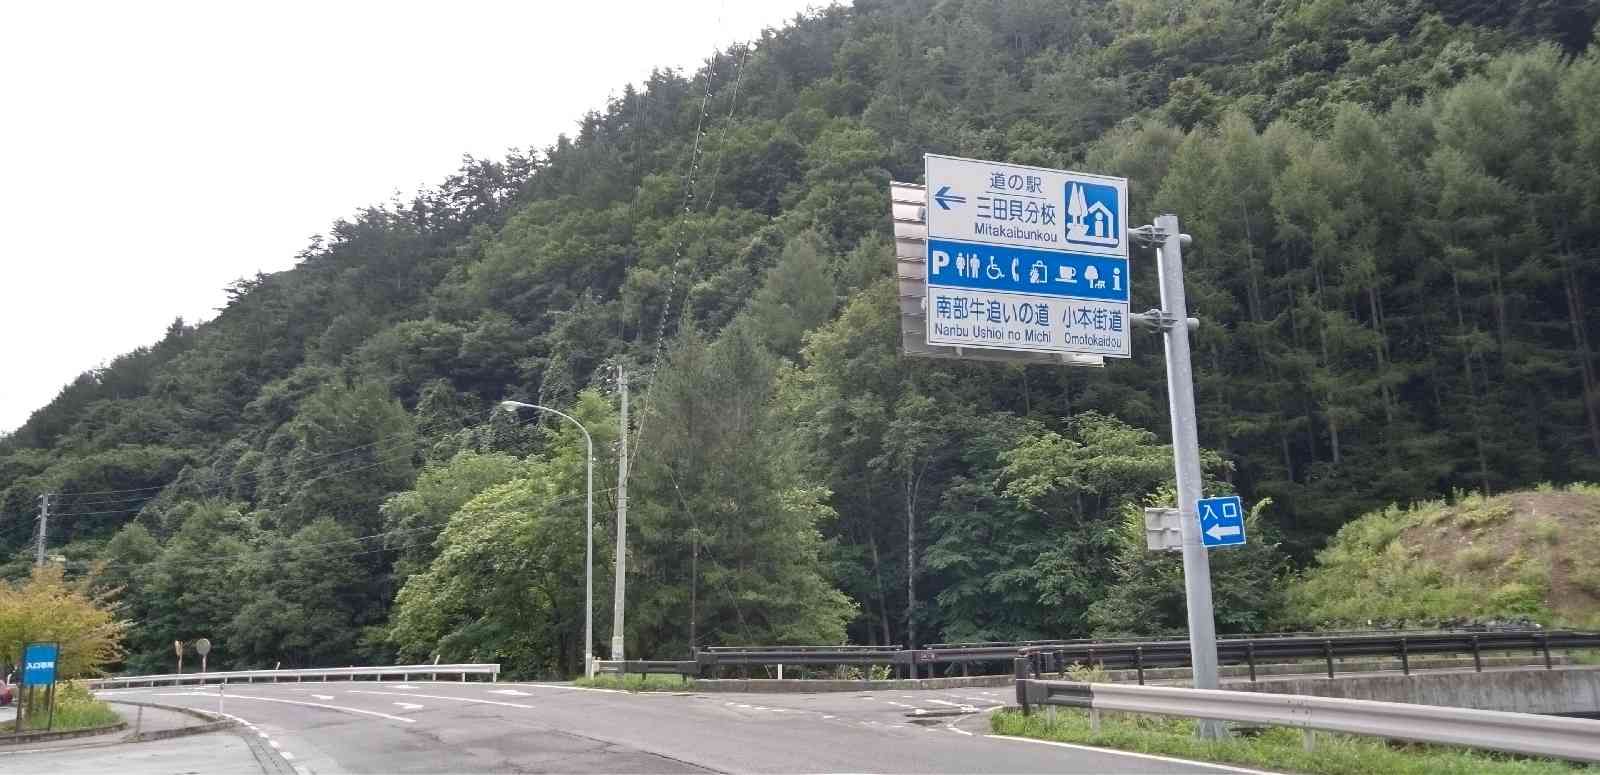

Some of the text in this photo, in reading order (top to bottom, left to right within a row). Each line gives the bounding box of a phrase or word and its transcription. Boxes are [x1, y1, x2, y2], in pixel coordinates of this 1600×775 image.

[990, 172, 1043, 193] 道の駅
[976, 196, 1056, 225] 三田貝分校
[974, 223, 1058, 243] Mitakaibunkou
[932, 250, 950, 275] P
[936, 296, 1123, 332] 南部牛追いの道 小本街道
[935, 323, 1122, 348] Nanbu Ushioi no Michi Omotokaidou
[1203, 503, 1237, 520] 入口
